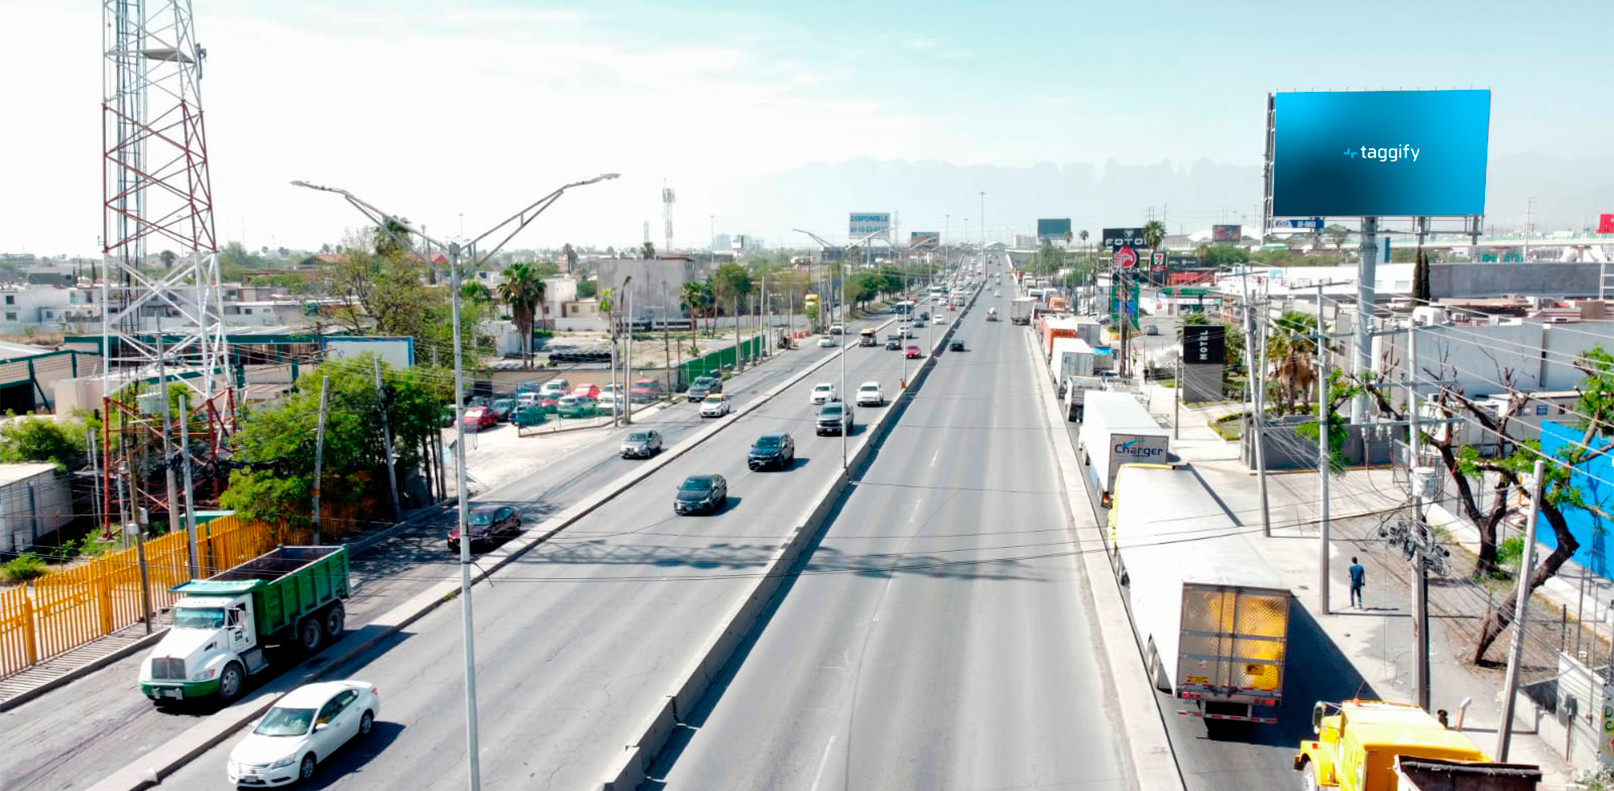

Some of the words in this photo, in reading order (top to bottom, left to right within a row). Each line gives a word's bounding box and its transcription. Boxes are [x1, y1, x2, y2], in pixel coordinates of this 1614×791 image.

[1360, 143, 1420, 162] taggify
[1199, 330, 1208, 360] MOTEL
[1114, 441, 1163, 457] Charger
